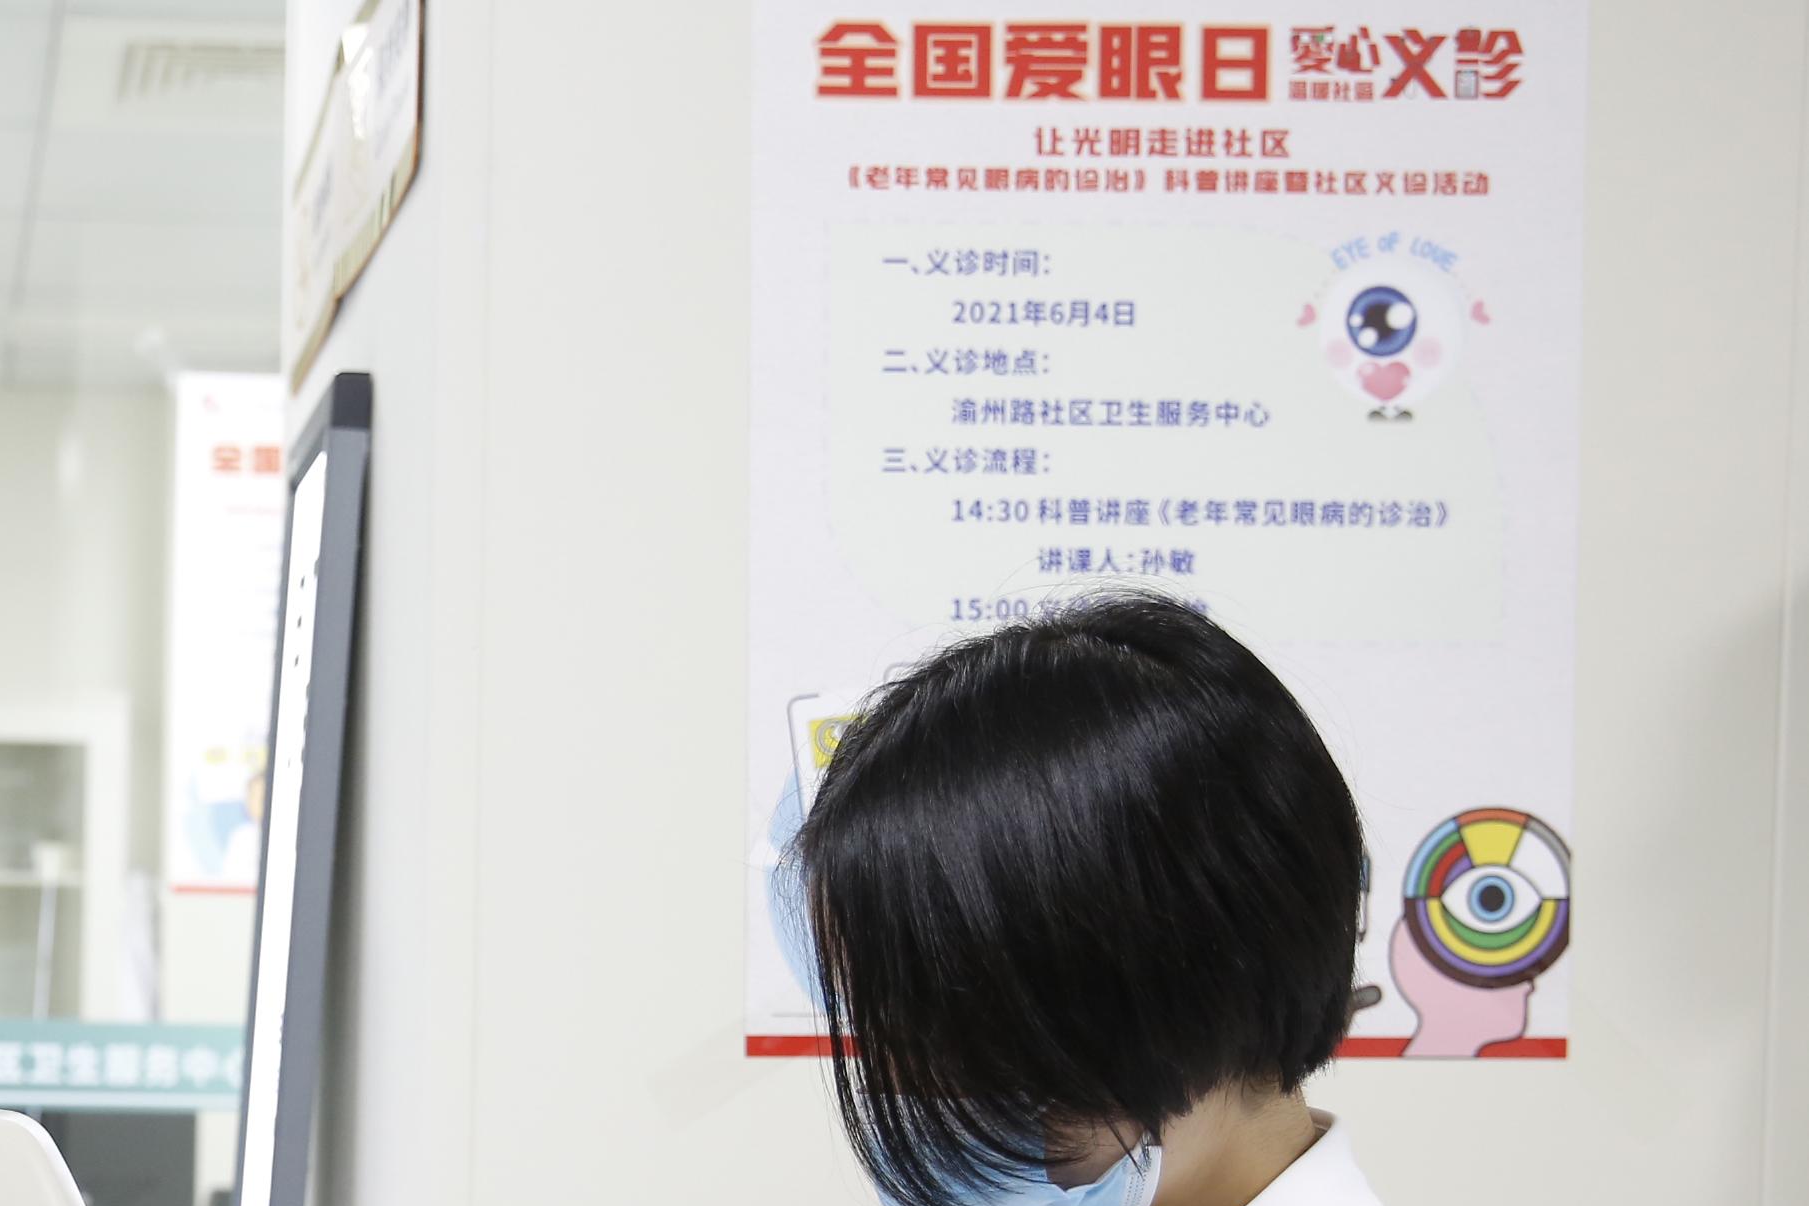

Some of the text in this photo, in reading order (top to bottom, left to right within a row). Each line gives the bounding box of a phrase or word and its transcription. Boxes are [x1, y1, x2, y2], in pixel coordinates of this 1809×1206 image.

[815, 21, 1270, 102] 全国爱眼日
[1034, 126, 1291, 159] 让光明走进社区
[1164, 168, 1490, 196] 科普讲座暨社区义诊活动
[1330, 237, 1372, 270] EYE
[1409, 236, 1459, 272] LOVE
[951, 298, 1138, 328] 2021年6月4日
[951, 398, 1271, 429] 渝州路社区卫生服务中心
[951, 497, 1451, 528] 14:30 科普讲座《老年常见眼病的诊治》
[950, 598, 1030, 622] 15:00
